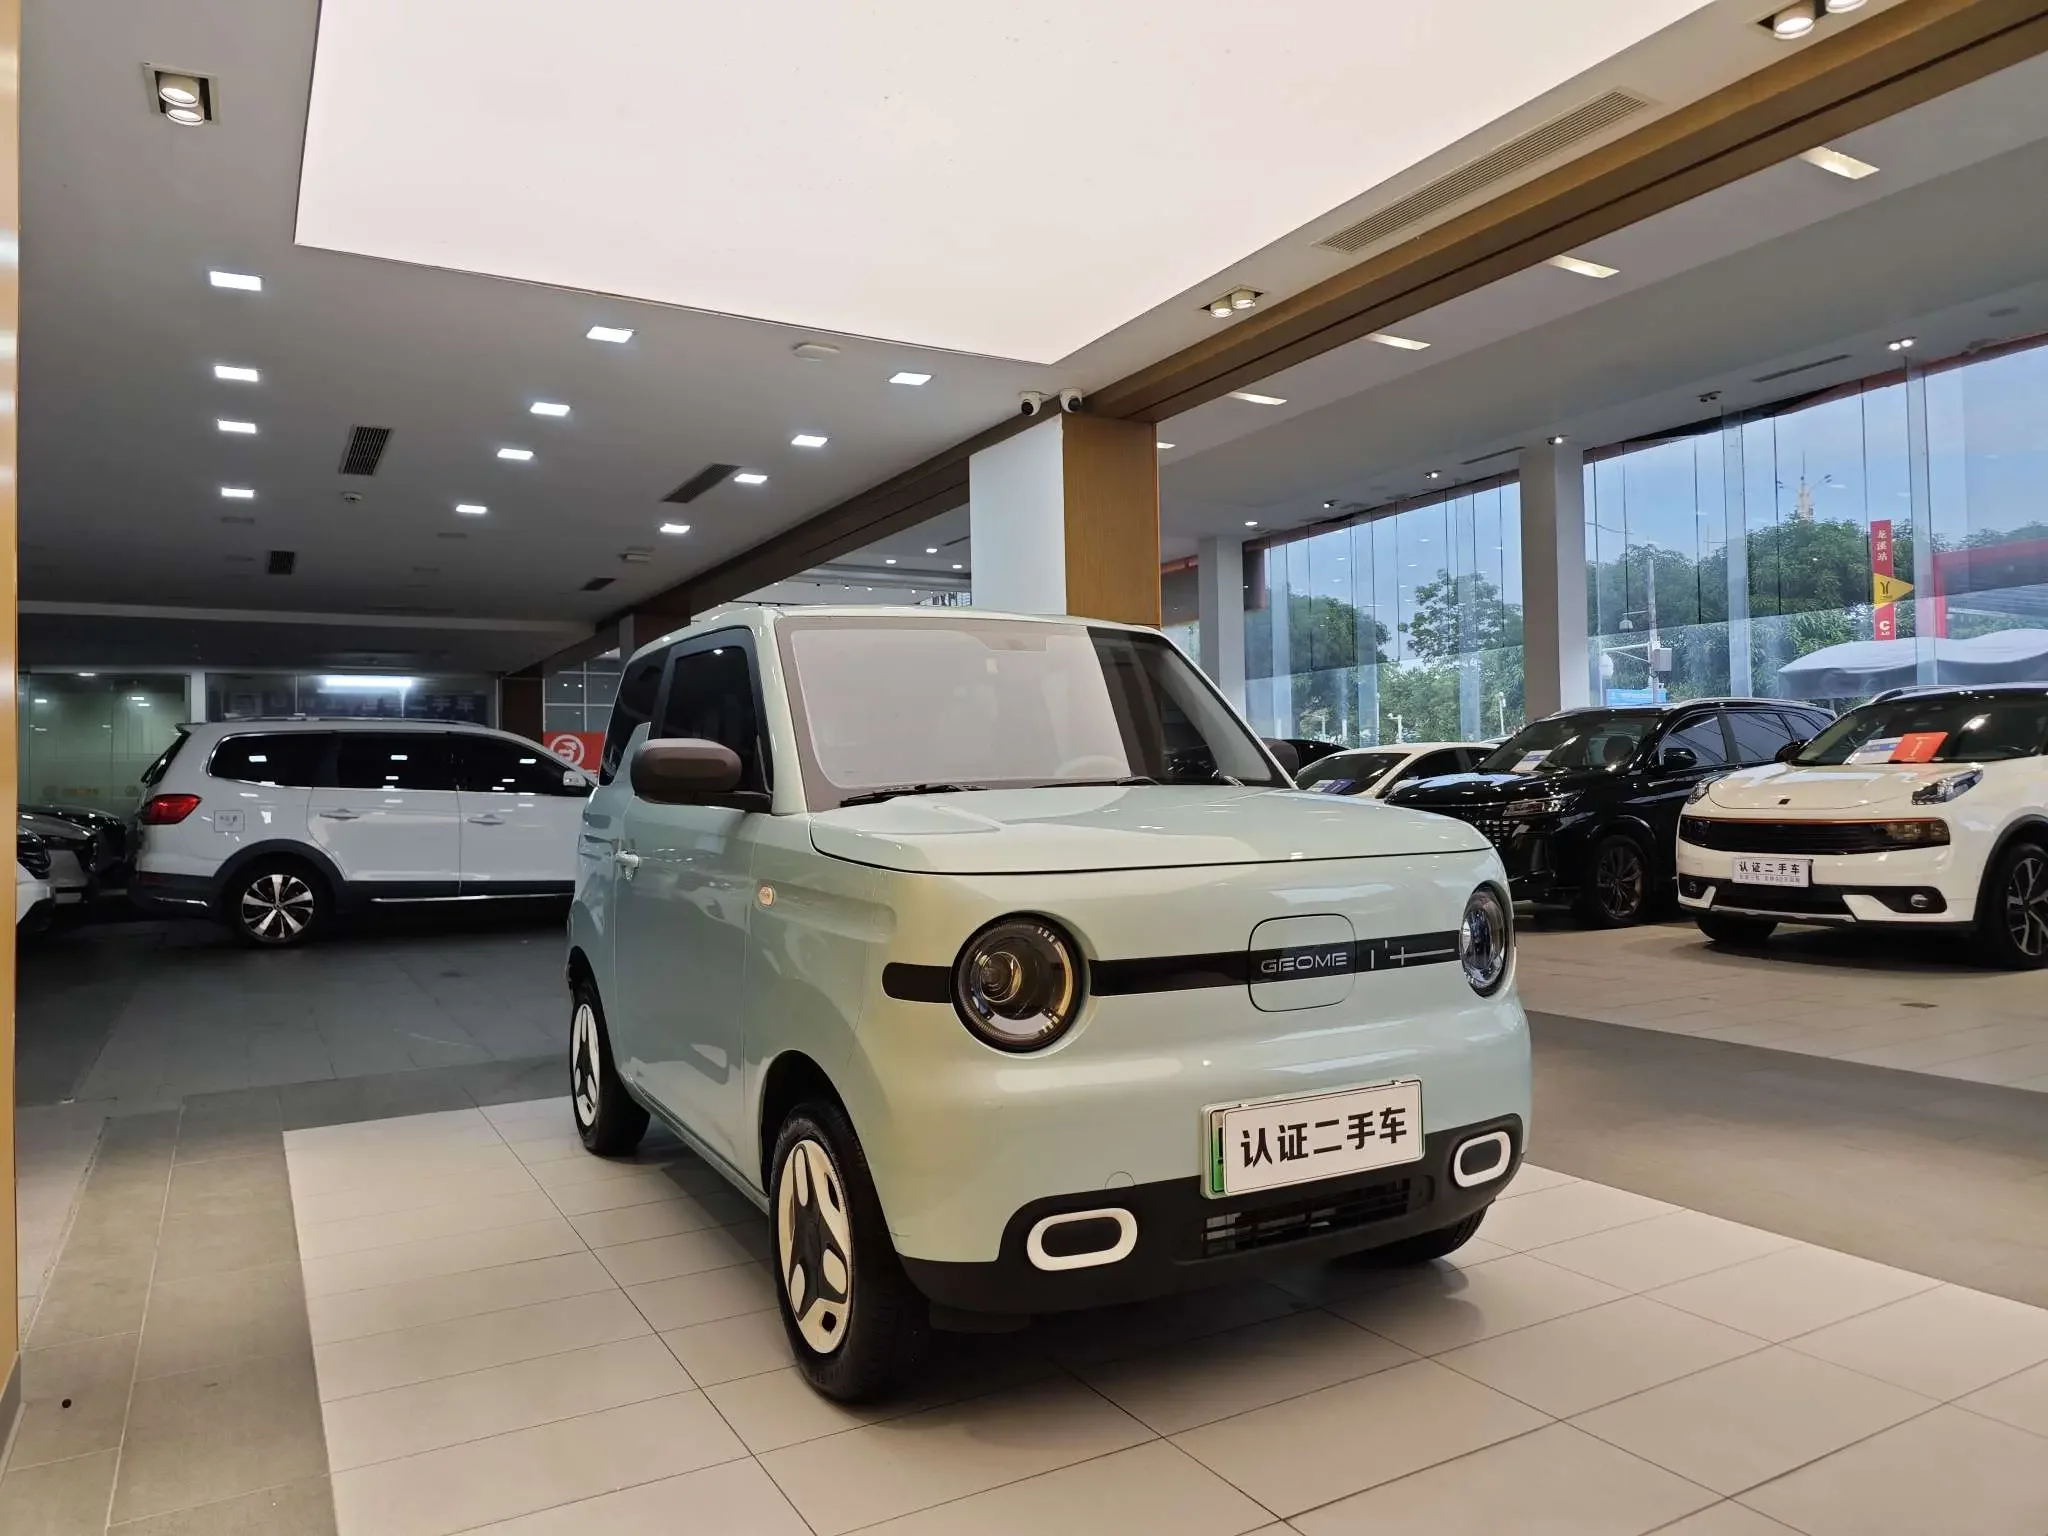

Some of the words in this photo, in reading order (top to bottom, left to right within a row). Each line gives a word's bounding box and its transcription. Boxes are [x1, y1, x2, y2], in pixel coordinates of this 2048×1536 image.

[1879, 620, 1890, 631] C
[1739, 861, 1800, 875] 认证二手车
[1260, 952, 1347, 973] GEOME
[1240, 1106, 1407, 1168] 认证二手车
